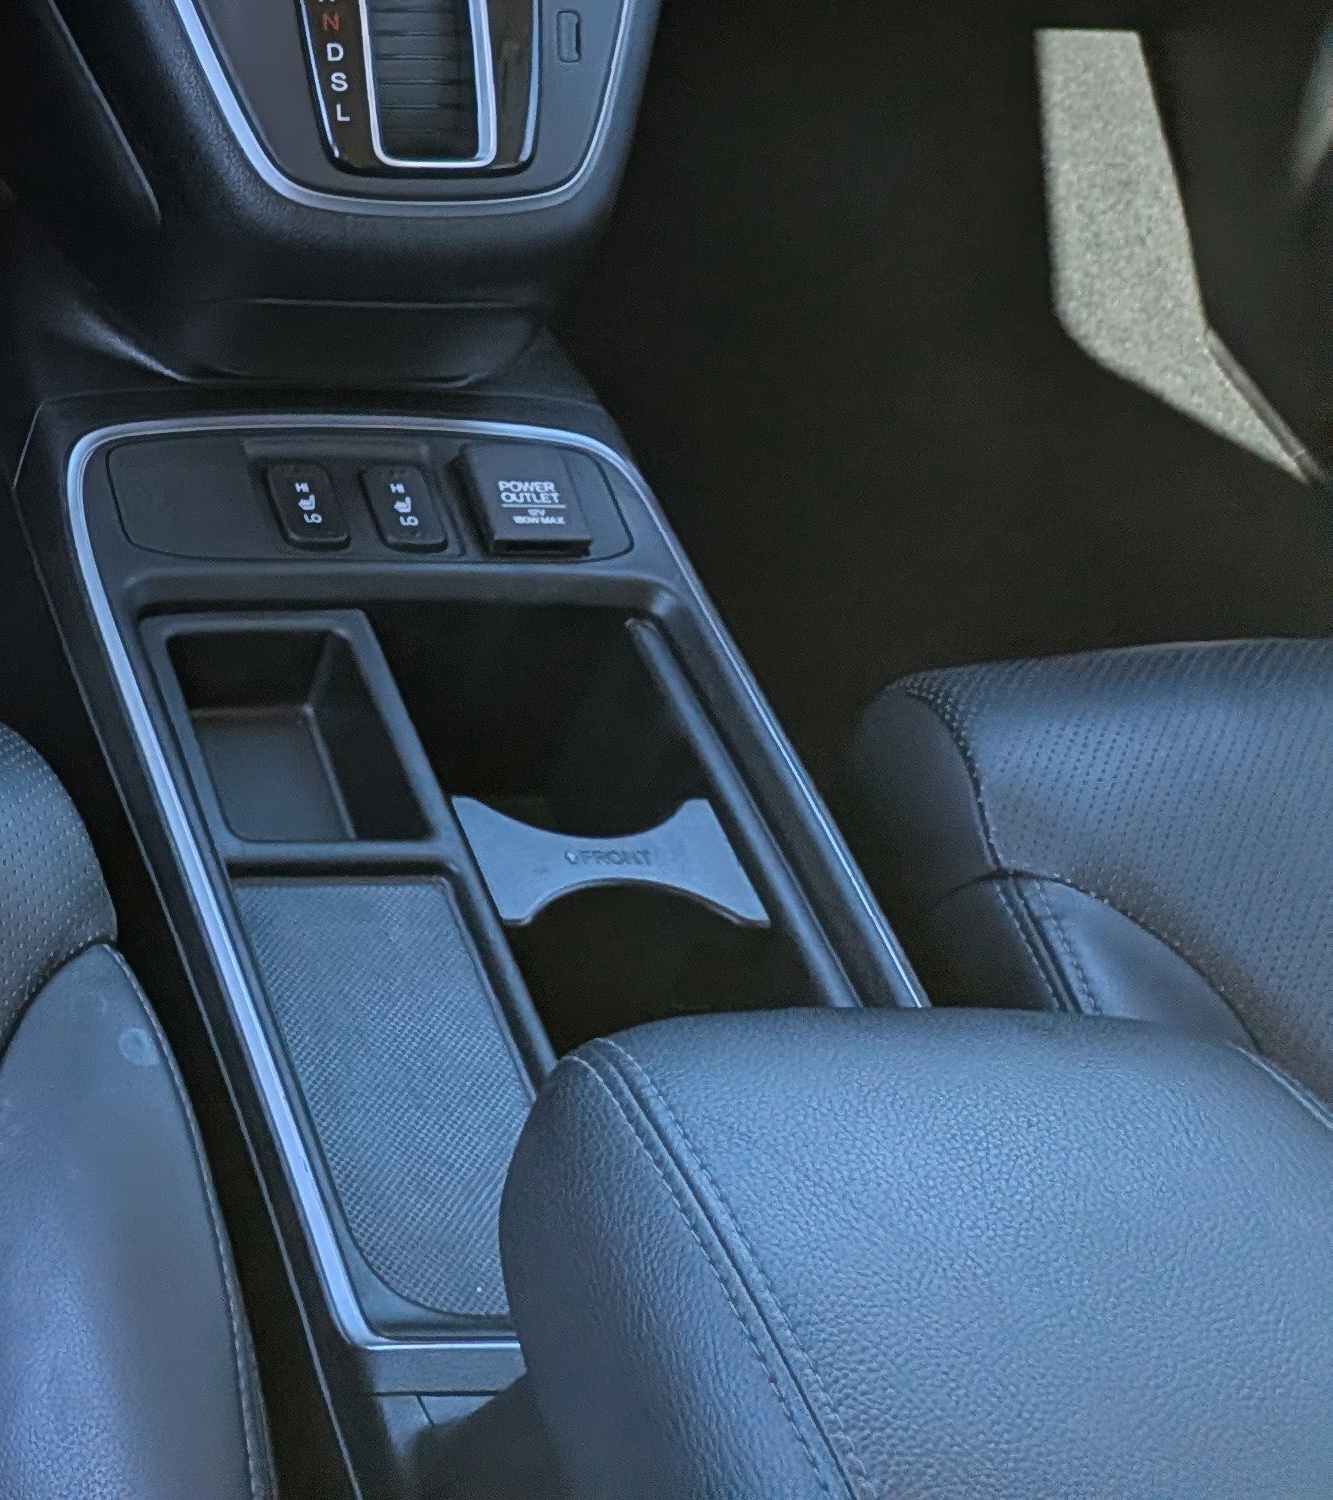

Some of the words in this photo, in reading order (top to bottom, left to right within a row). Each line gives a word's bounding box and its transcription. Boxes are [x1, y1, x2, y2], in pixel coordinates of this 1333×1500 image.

[322, 12, 340, 31] N
[327, 43, 344, 62] D
[331, 72, 348, 92] S
[336, 104, 350, 122] L
[498, 481, 555, 492] POWER
[501, 492, 559, 503] OUTLET
